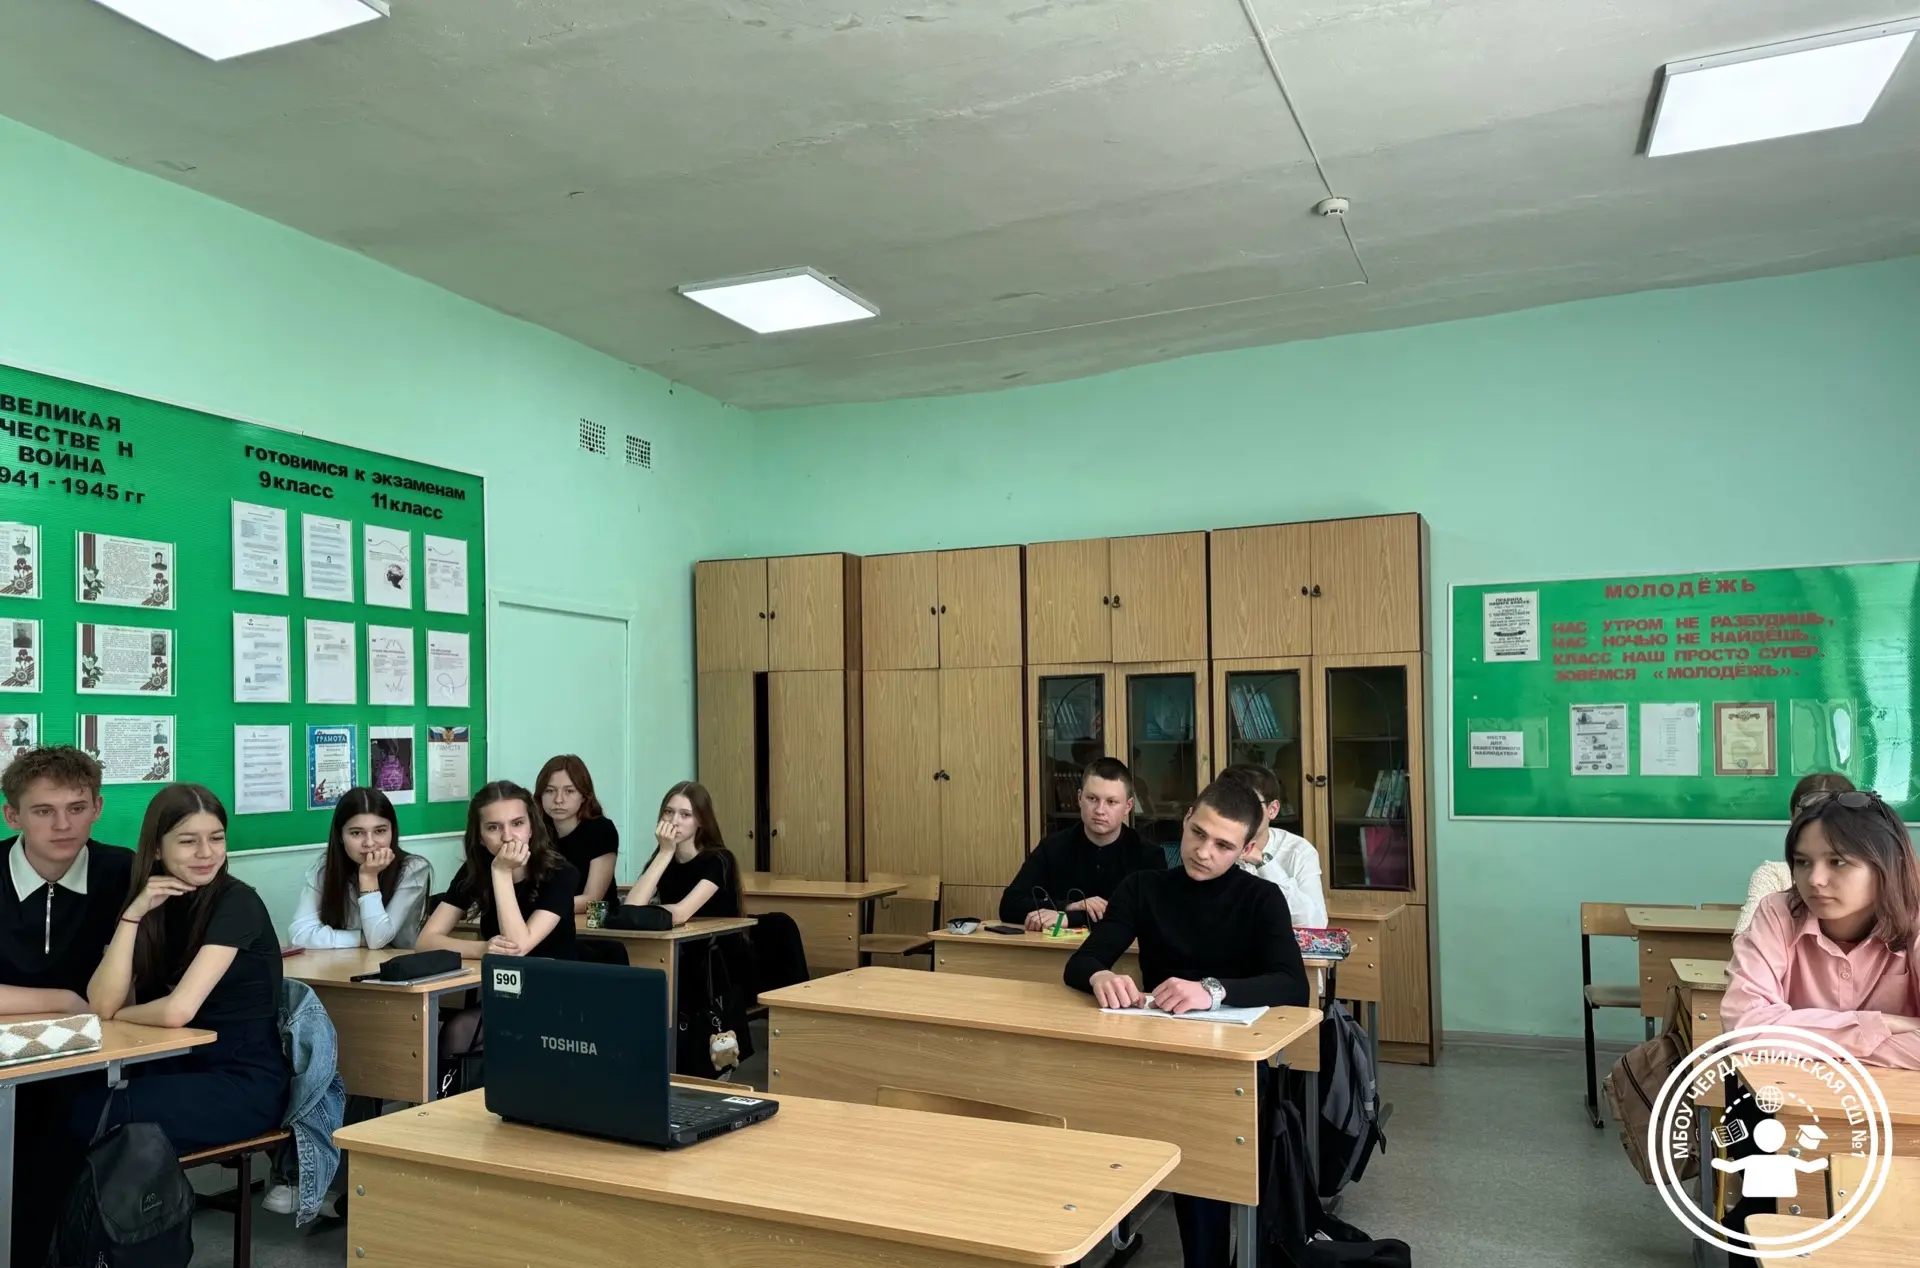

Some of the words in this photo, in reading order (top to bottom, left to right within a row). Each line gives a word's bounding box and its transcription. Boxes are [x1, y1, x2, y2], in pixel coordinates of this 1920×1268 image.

[0, 393, 121, 433] ВЕЛИКАЯ
[0, 417, 100, 451] ЧЕСТВЕ
[19, 445, 106, 475] ВОЙНА
[245, 445, 348, 477] готовимся
[372, 471, 465, 500] экзаменам
[62, 477, 119, 500] 1945
[125, 491, 145, 504] гг
[1605, 578, 1756, 599] МОЛОДЁЖЬ
[1553, 622, 1587, 634] НАС
[1604, 619, 1663, 632] УТРОМ
[1676, 617, 1700, 629] НЕ
[1553, 637, 1588, 649] НАС
[1603, 634, 1668, 647] НОЧЬЮ
[1677, 633, 1700, 645] НЕ
[1554, 653, 1612, 665] КЛАСС
[1623, 651, 1665, 663] НАШ
[1675, 648, 1750, 662] ПРОСТО
[1556, 667, 1637, 682] ЗОВЁМСЯ
[541, 1035, 598, 1056] TOSHIBA
